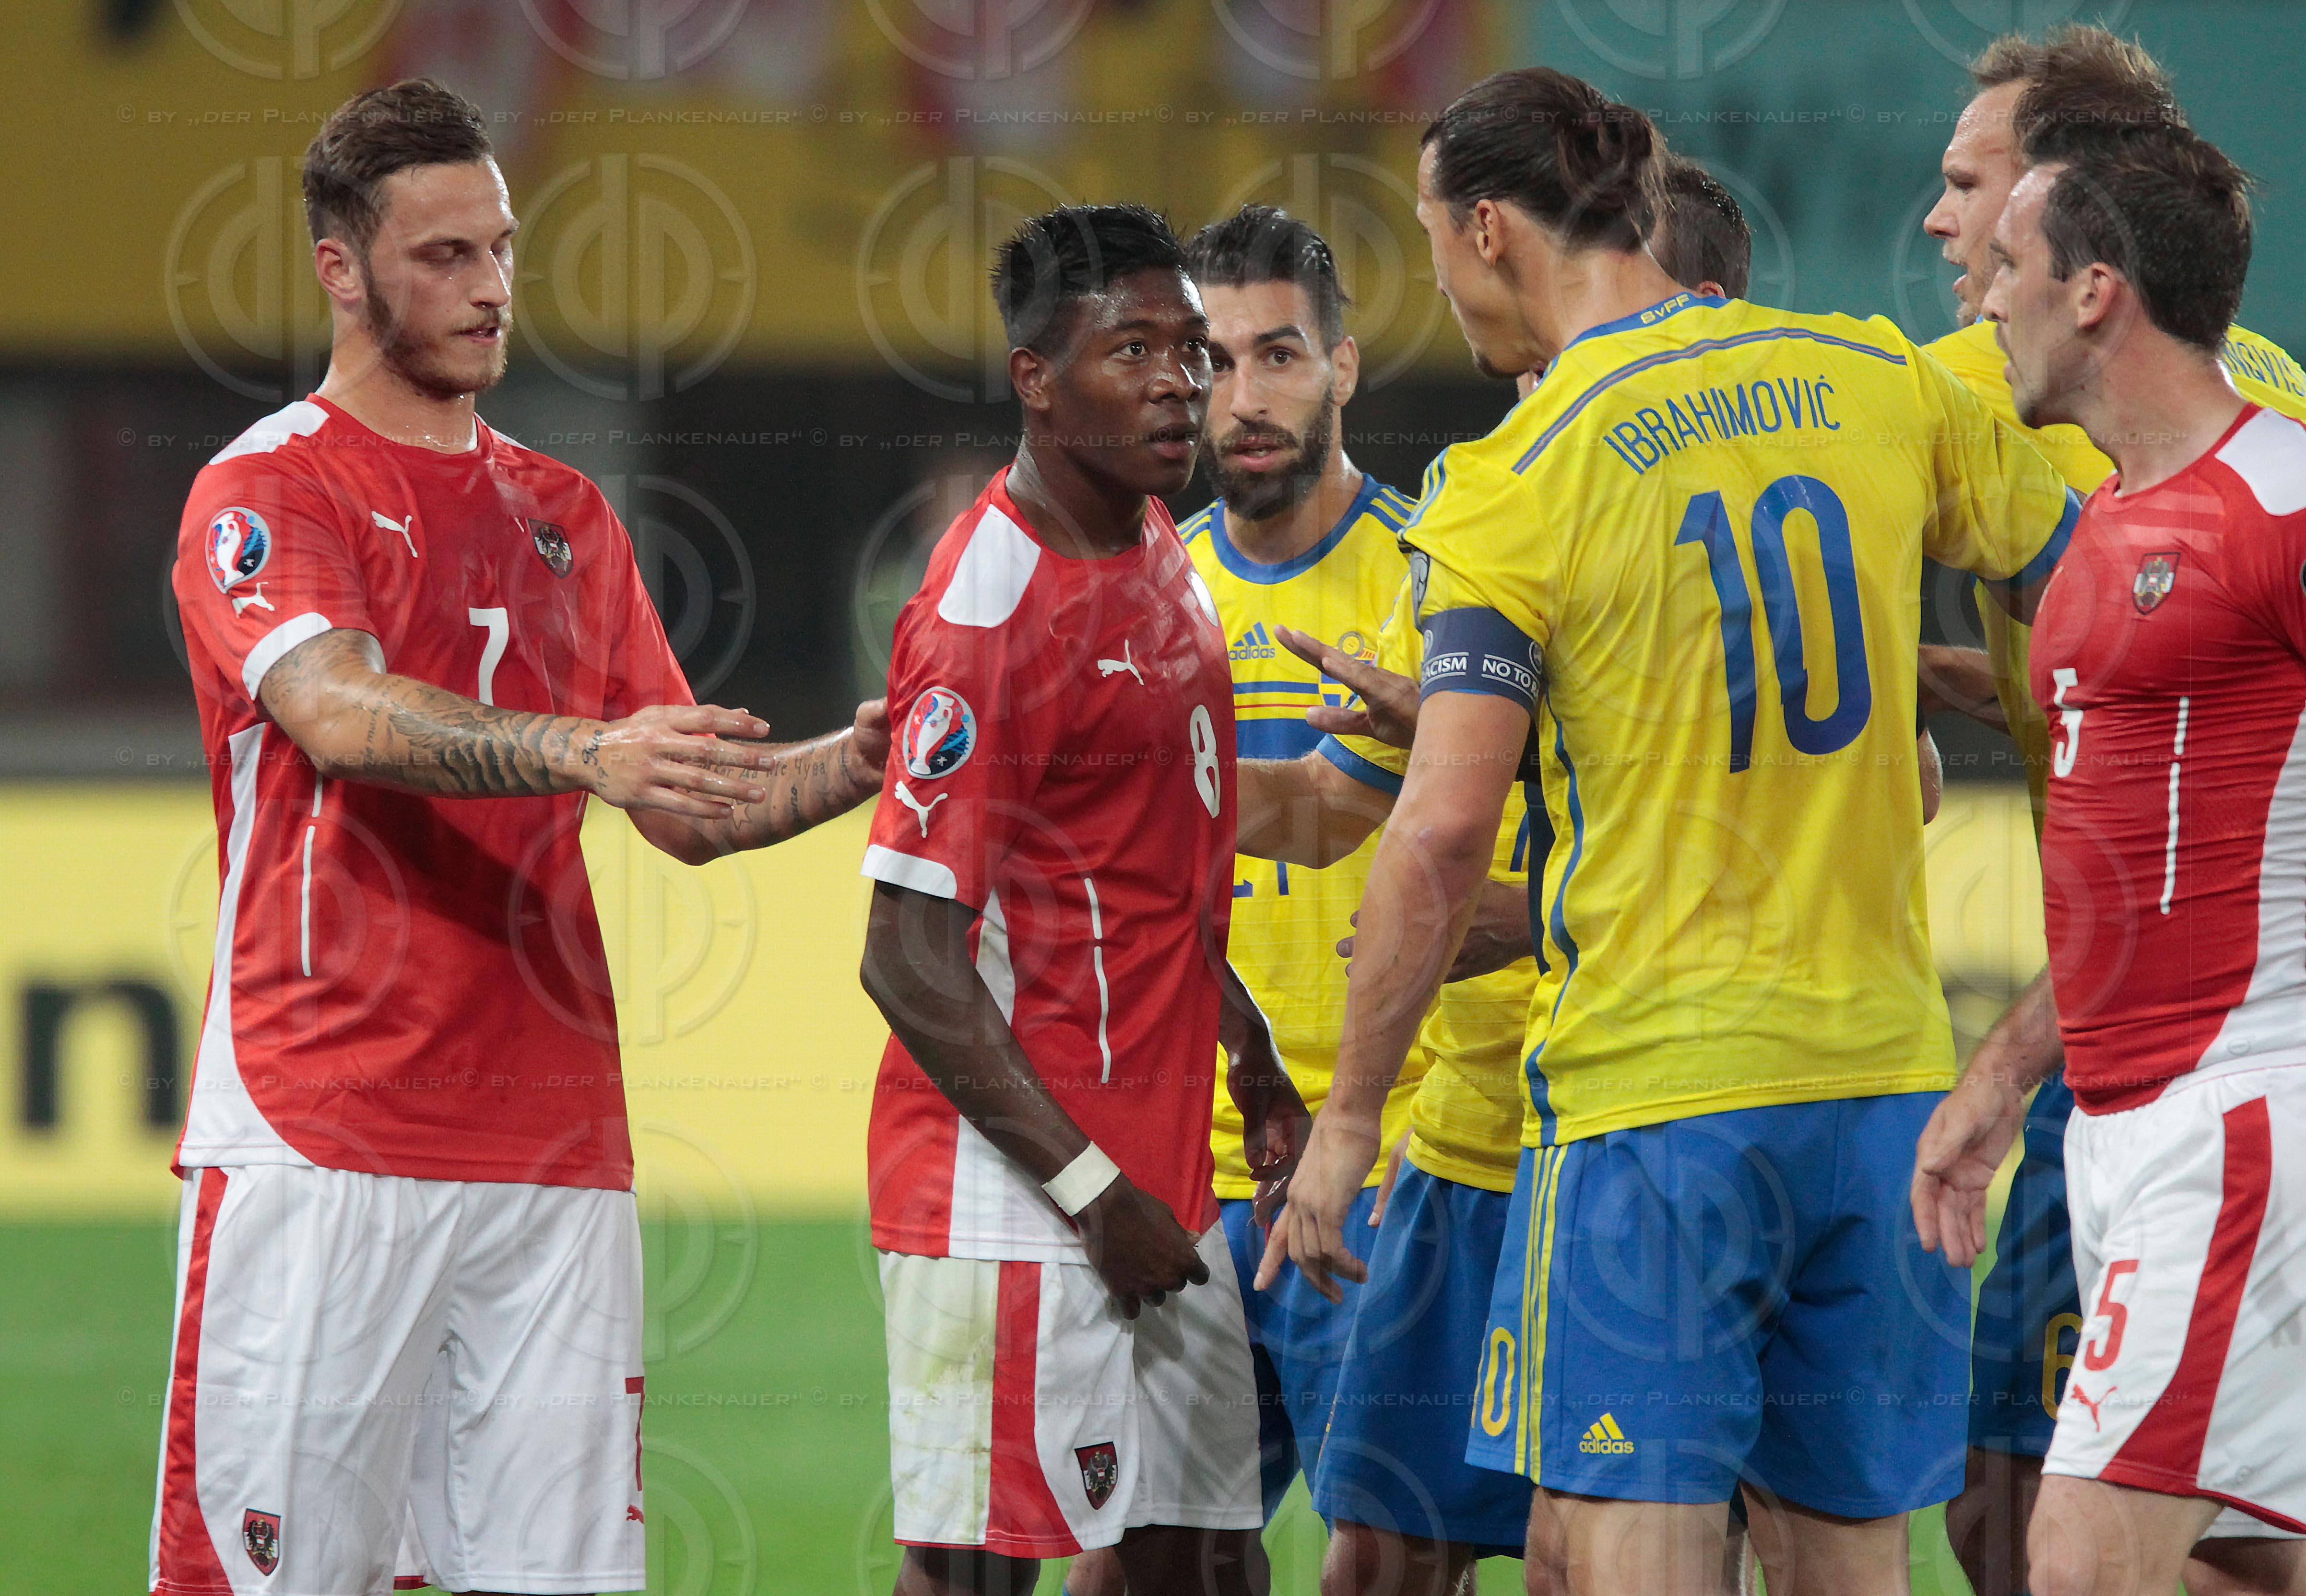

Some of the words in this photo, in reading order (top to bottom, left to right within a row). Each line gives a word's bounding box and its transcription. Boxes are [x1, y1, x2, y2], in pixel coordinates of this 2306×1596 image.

[1603, 374, 1841, 475] IBRAHIMOVIĆ
[468, 607, 509, 707] 7
[1229, 646, 1276, 661] adidas
[1422, 657, 1467, 682] ACISM
[1482, 658, 1511, 677] NO
[1514, 667, 1531, 688] TO
[1674, 474, 1872, 774] 10
[1190, 704, 1221, 819] 8
[2053, 668, 2084, 778] 5
[2084, 1259, 2140, 1372] 5
[2042, 1312, 2084, 1421] 6
[1579, 1438, 1635, 1455] adidas
